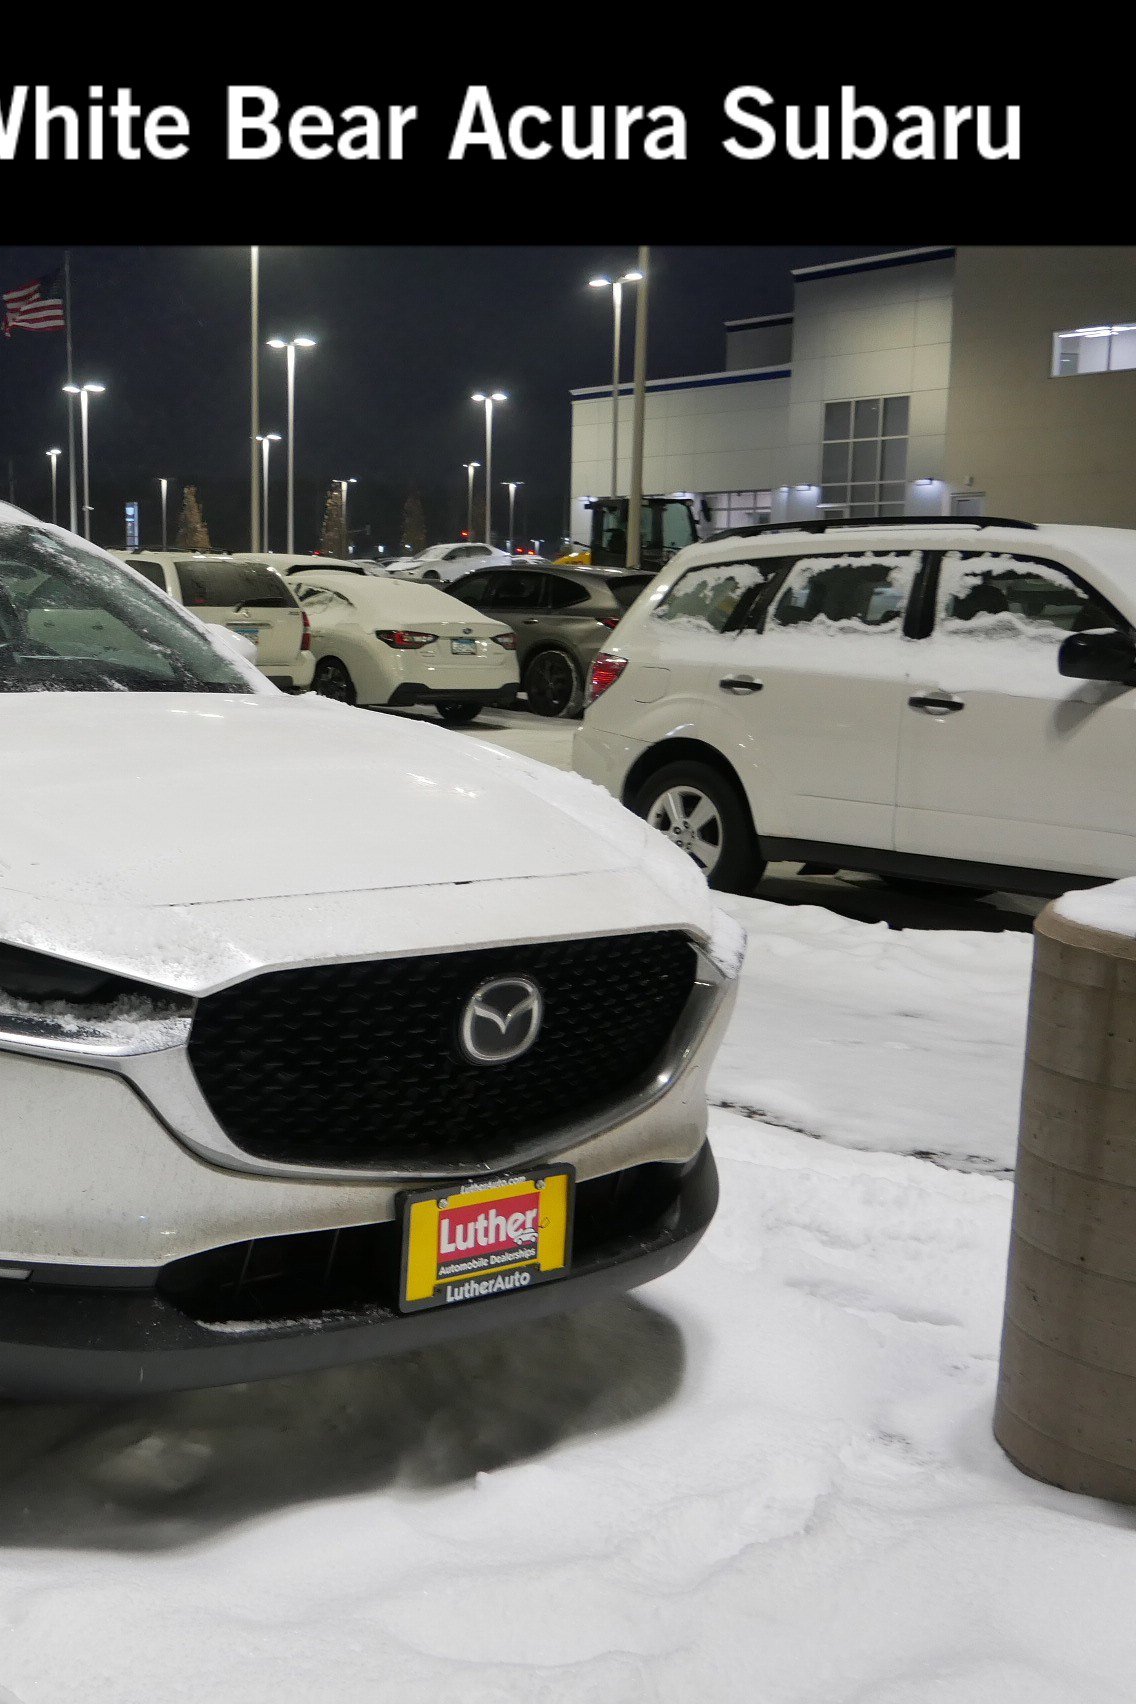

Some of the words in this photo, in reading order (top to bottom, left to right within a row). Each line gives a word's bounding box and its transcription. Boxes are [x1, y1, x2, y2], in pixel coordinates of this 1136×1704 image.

[440, 1208, 538, 1254] Luther
[439, 1261, 489, 1276] Automobile
[490, 1248, 536, 1266] Dealerships
[446, 1271, 531, 1302] LutherAuto
